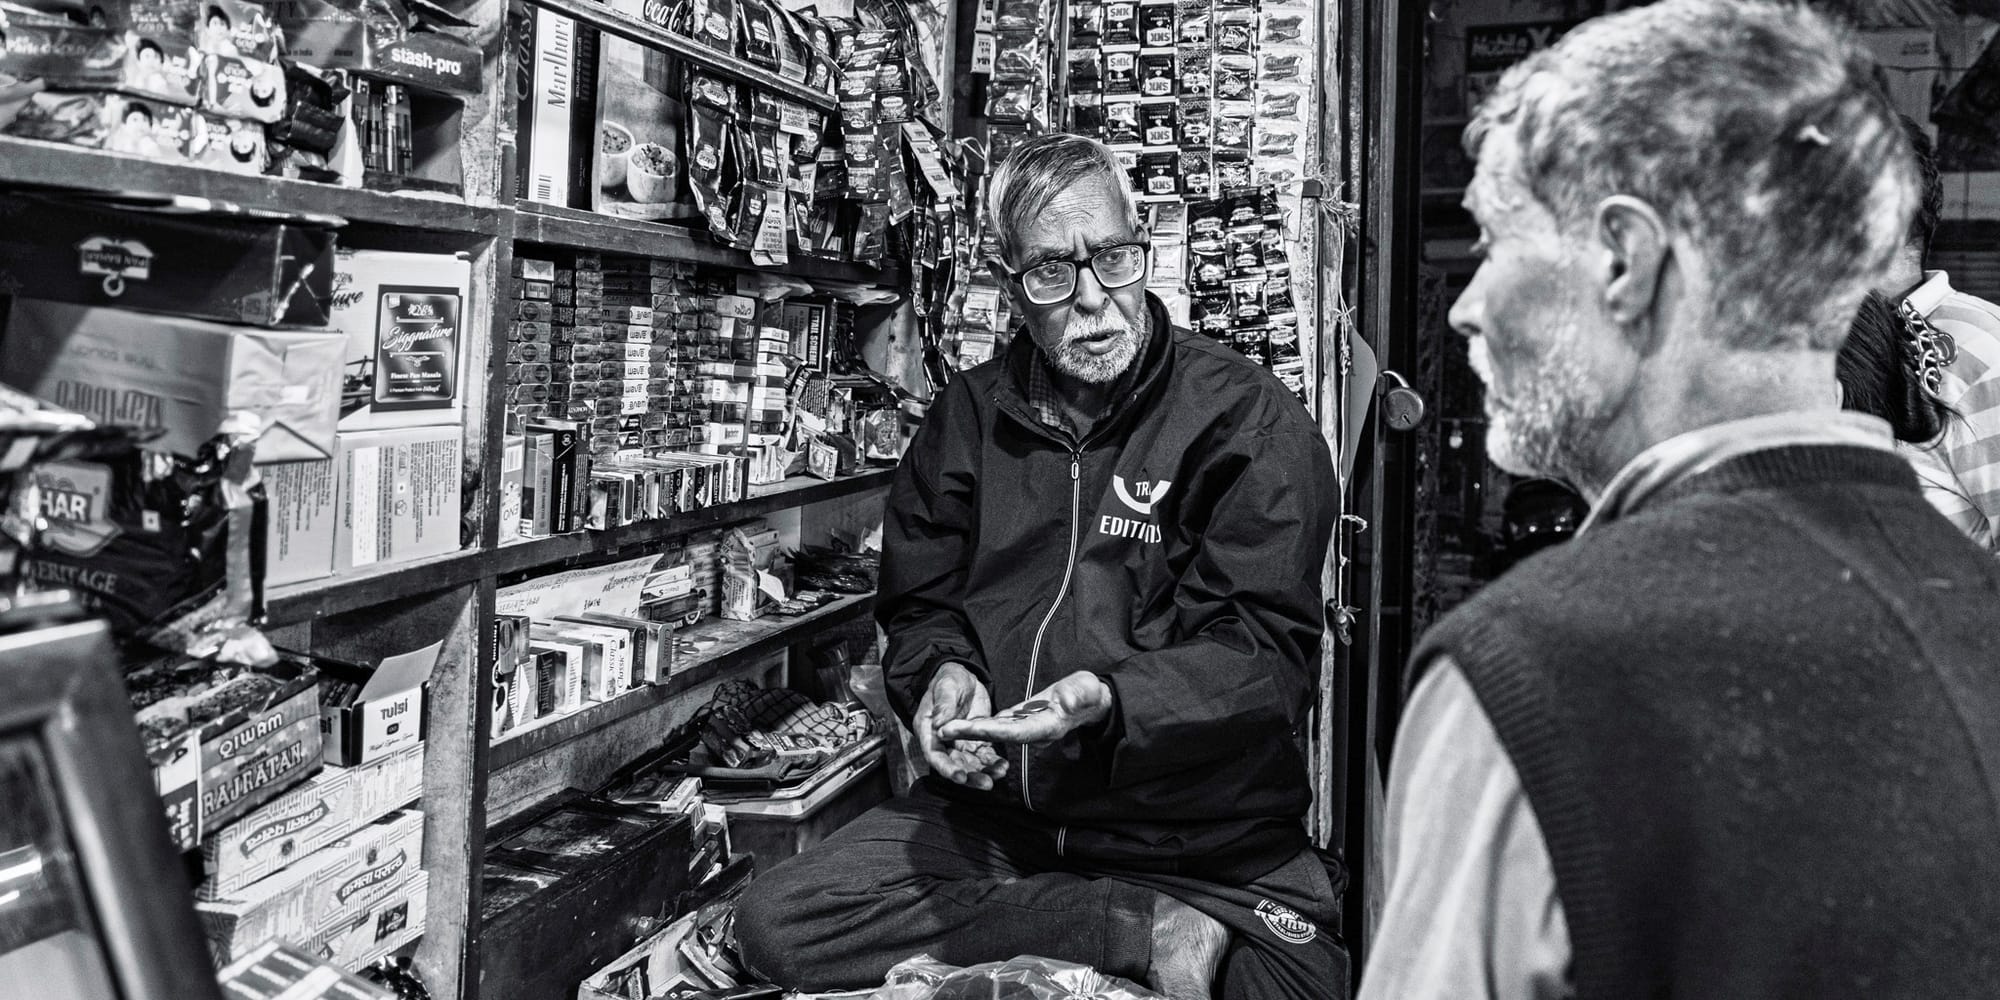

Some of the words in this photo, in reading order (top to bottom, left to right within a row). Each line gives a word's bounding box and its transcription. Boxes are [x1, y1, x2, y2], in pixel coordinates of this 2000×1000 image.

[391, 46, 462, 76] stash-pro
[382, 323, 454, 353] Siggnature
[1135, 480, 1152, 497] TR
[39, 489, 89, 522] HAR
[219, 712, 283, 760] QIWAM
[202, 741, 303, 817] RAJRATAN
